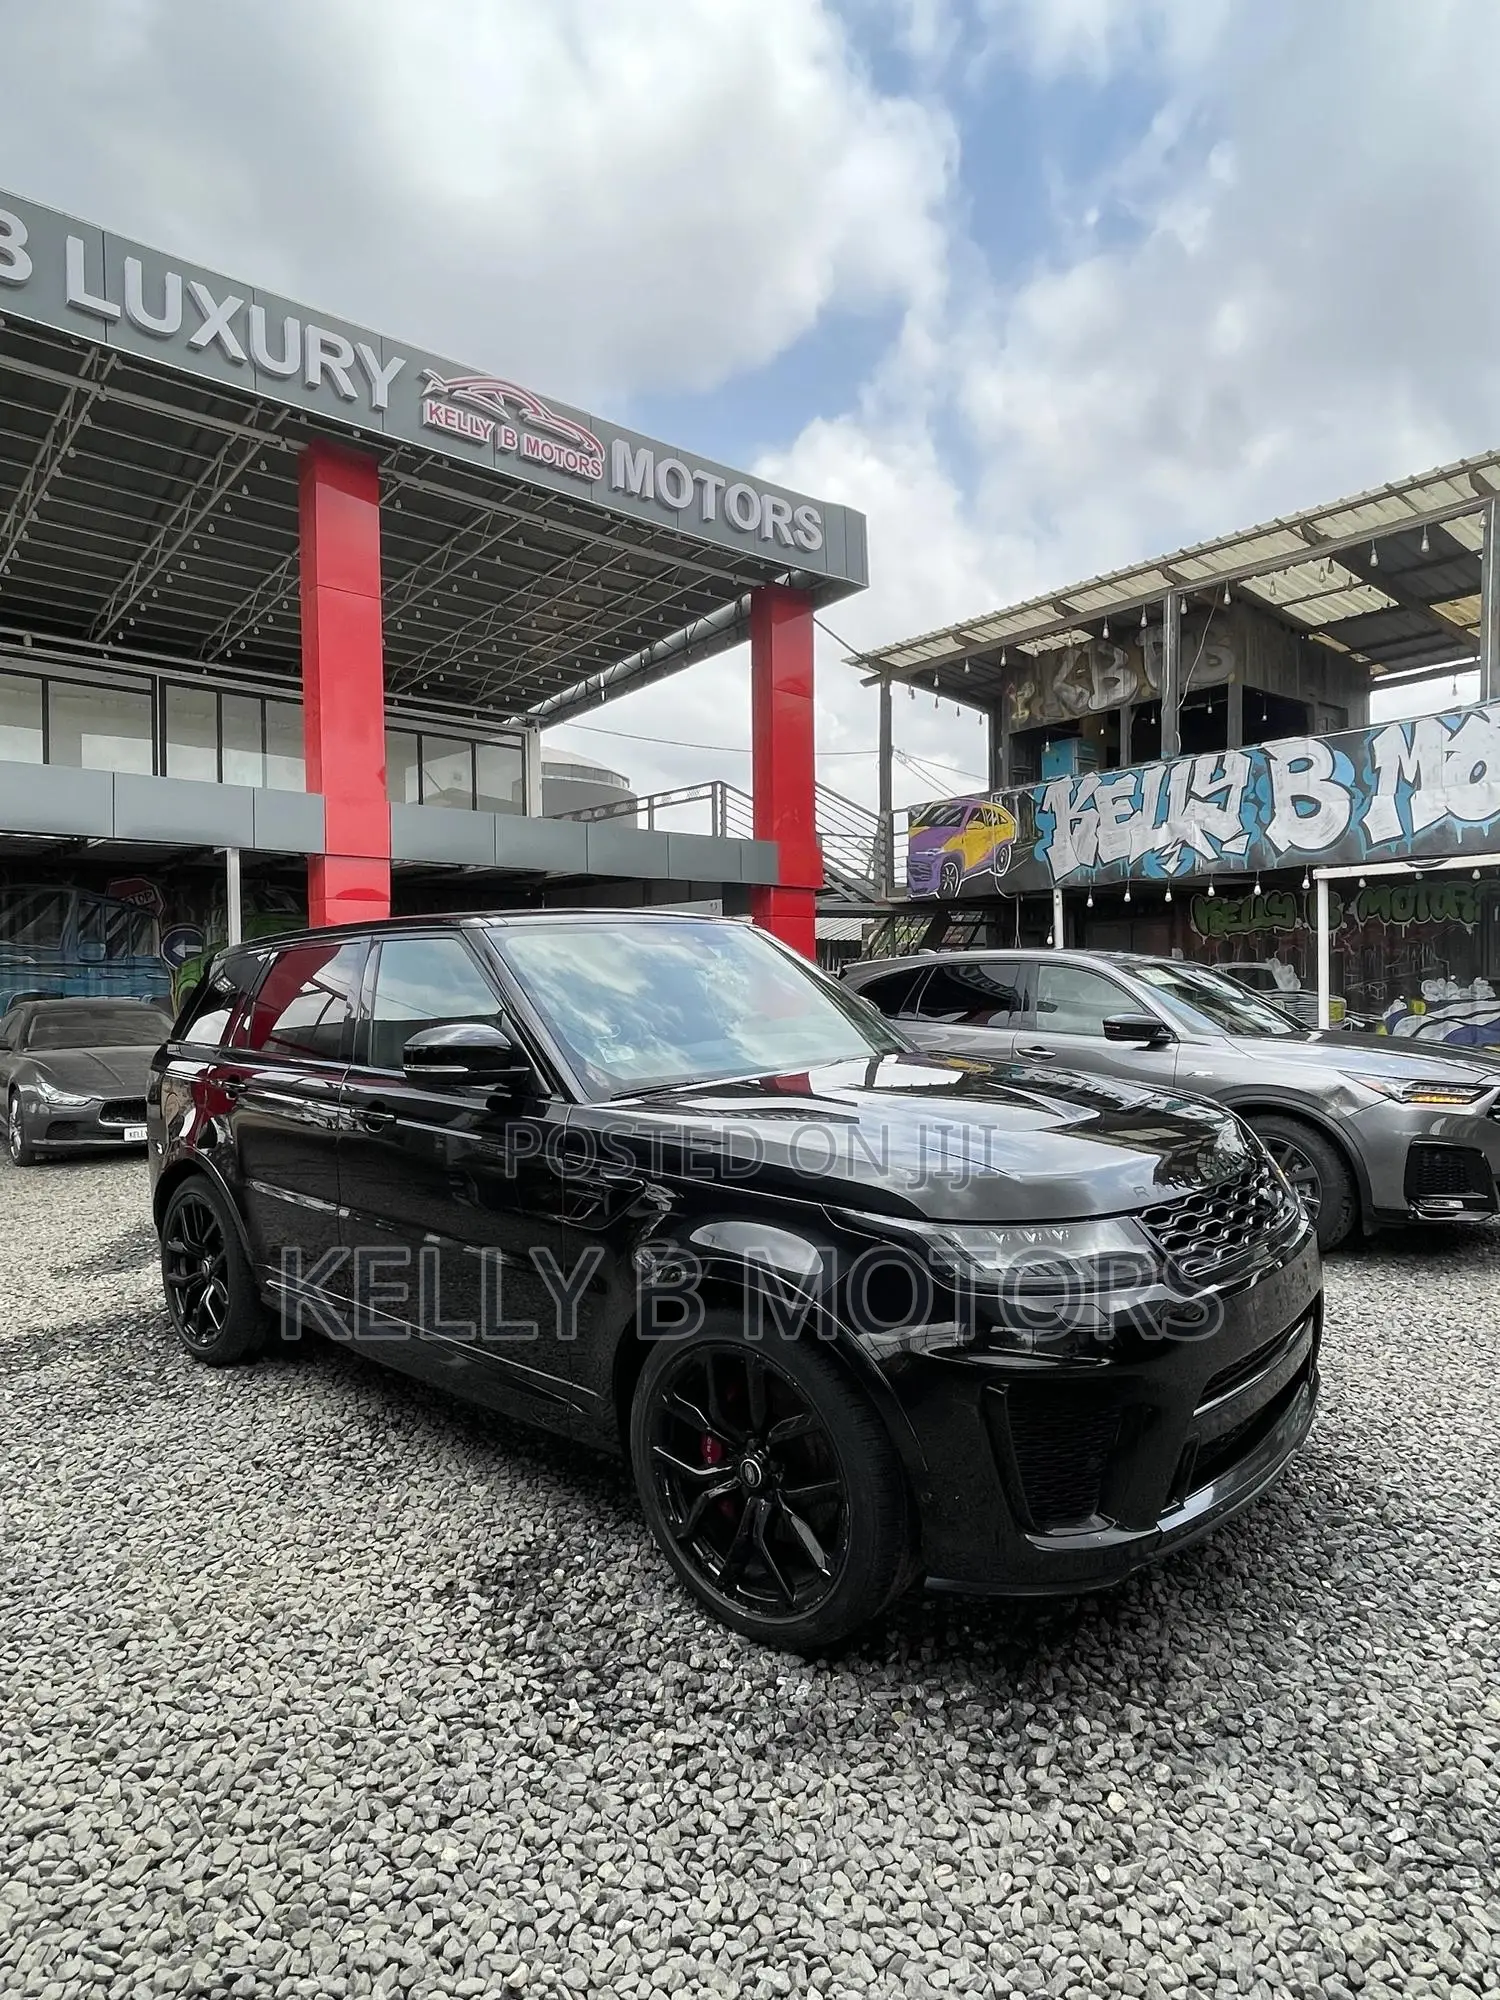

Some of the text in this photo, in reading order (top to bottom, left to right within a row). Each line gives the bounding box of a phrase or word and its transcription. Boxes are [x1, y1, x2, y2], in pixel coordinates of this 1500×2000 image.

[66, 234, 406, 412] LUXURY
[611, 438, 824, 552] MOTORS
[423, 399, 604, 480] KELLY B MOTORS
[1042, 749, 1251, 882] KELLY
[1262, 737, 1351, 852] B
[1191, 889, 1298, 937] KELLY
